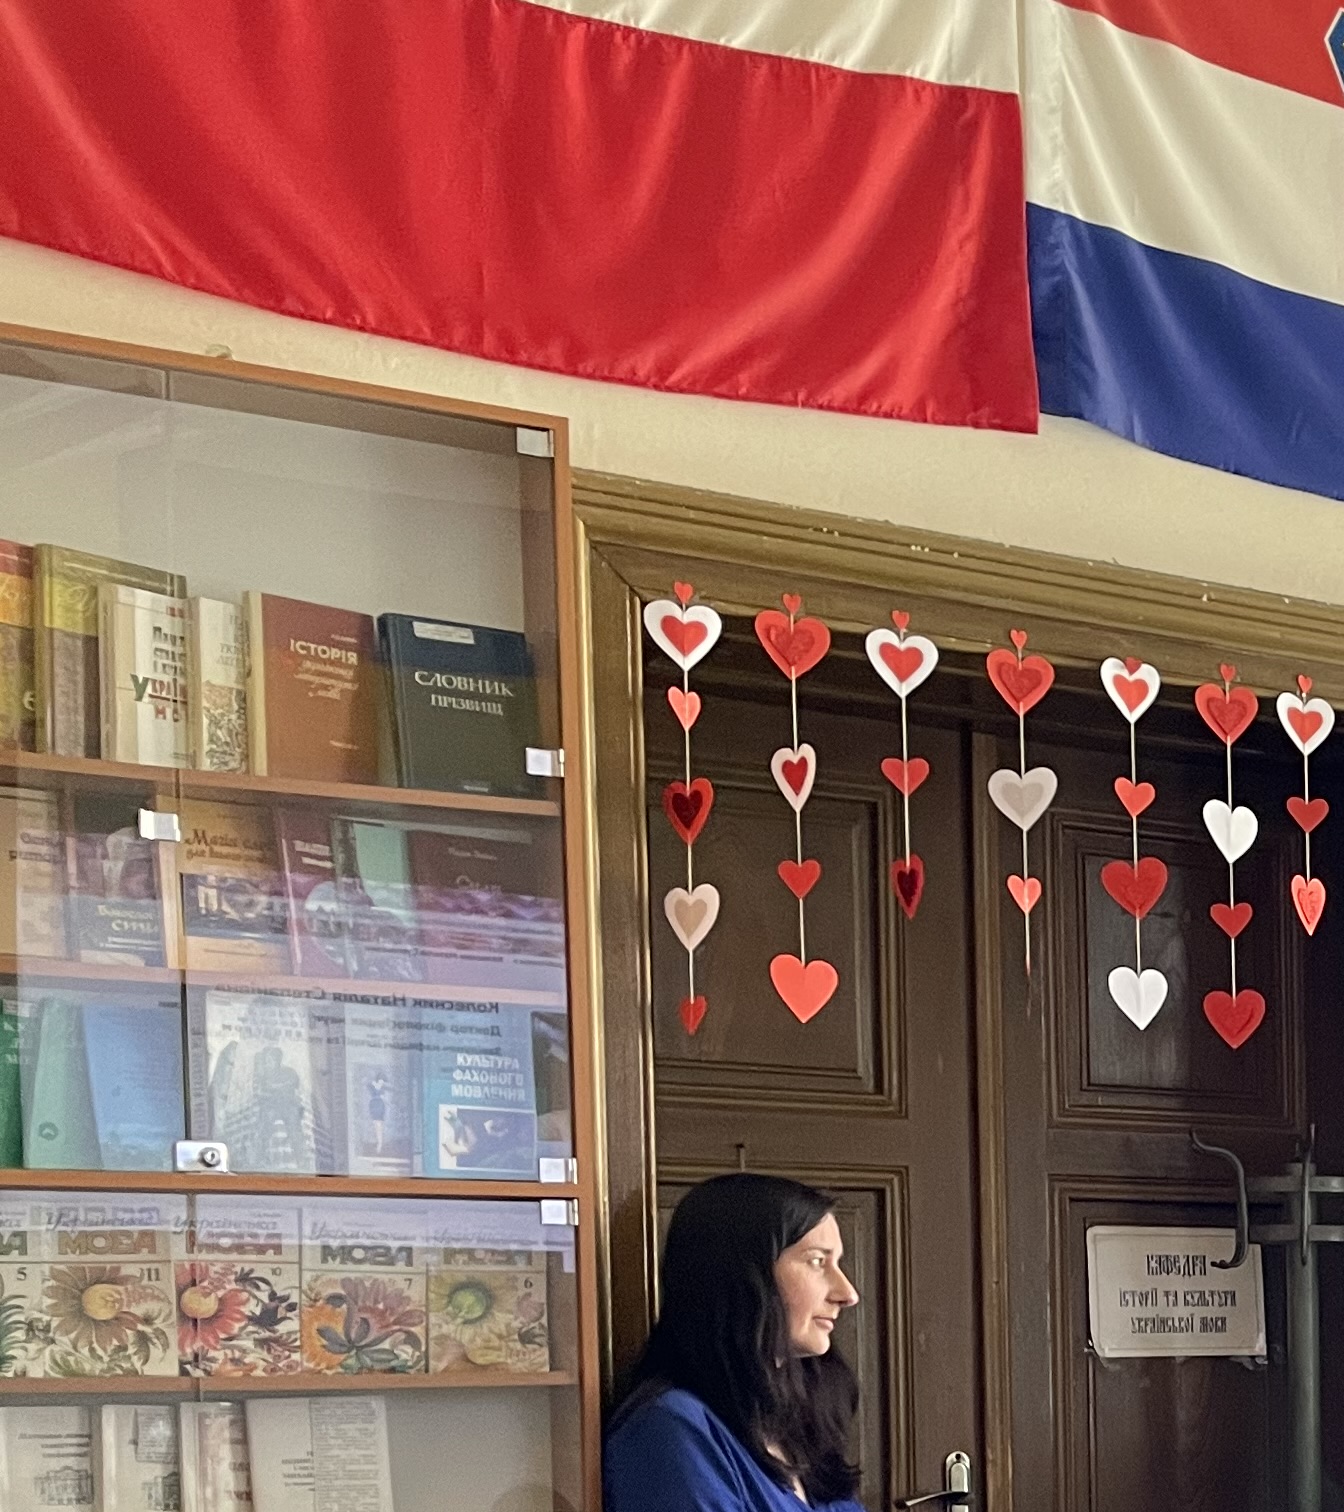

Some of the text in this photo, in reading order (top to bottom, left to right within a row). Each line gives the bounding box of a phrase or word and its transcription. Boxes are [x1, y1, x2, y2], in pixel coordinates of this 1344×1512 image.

[289, 638, 358, 665] ІСТОРІЯ
[414, 670, 515, 697] СЛОВНИК
[430, 694, 503, 717] ПРІЗВИЩ
[456, 1053, 520, 1069] КУЛЬТУРА
[452, 1068, 525, 1087] ФАХОВОГО
[451, 1083, 526, 1102] МОВЛЕННЯ
[16, 1267, 27, 1281] 5
[147, 1268, 161, 1282] 11
[270, 1266, 282, 1276] 10
[1147, 1254, 1207, 1278] КАФЕДРА
[403, 1278, 413, 1290] 7
[523, 1278, 533, 1289] 6
[1119, 1288, 1237, 1308] ІСТОРІЇ ТА КУЛЬТУРИ
[1130, 1312, 1227, 1335] УКРАЇНСЬКОЇ МОВИ
